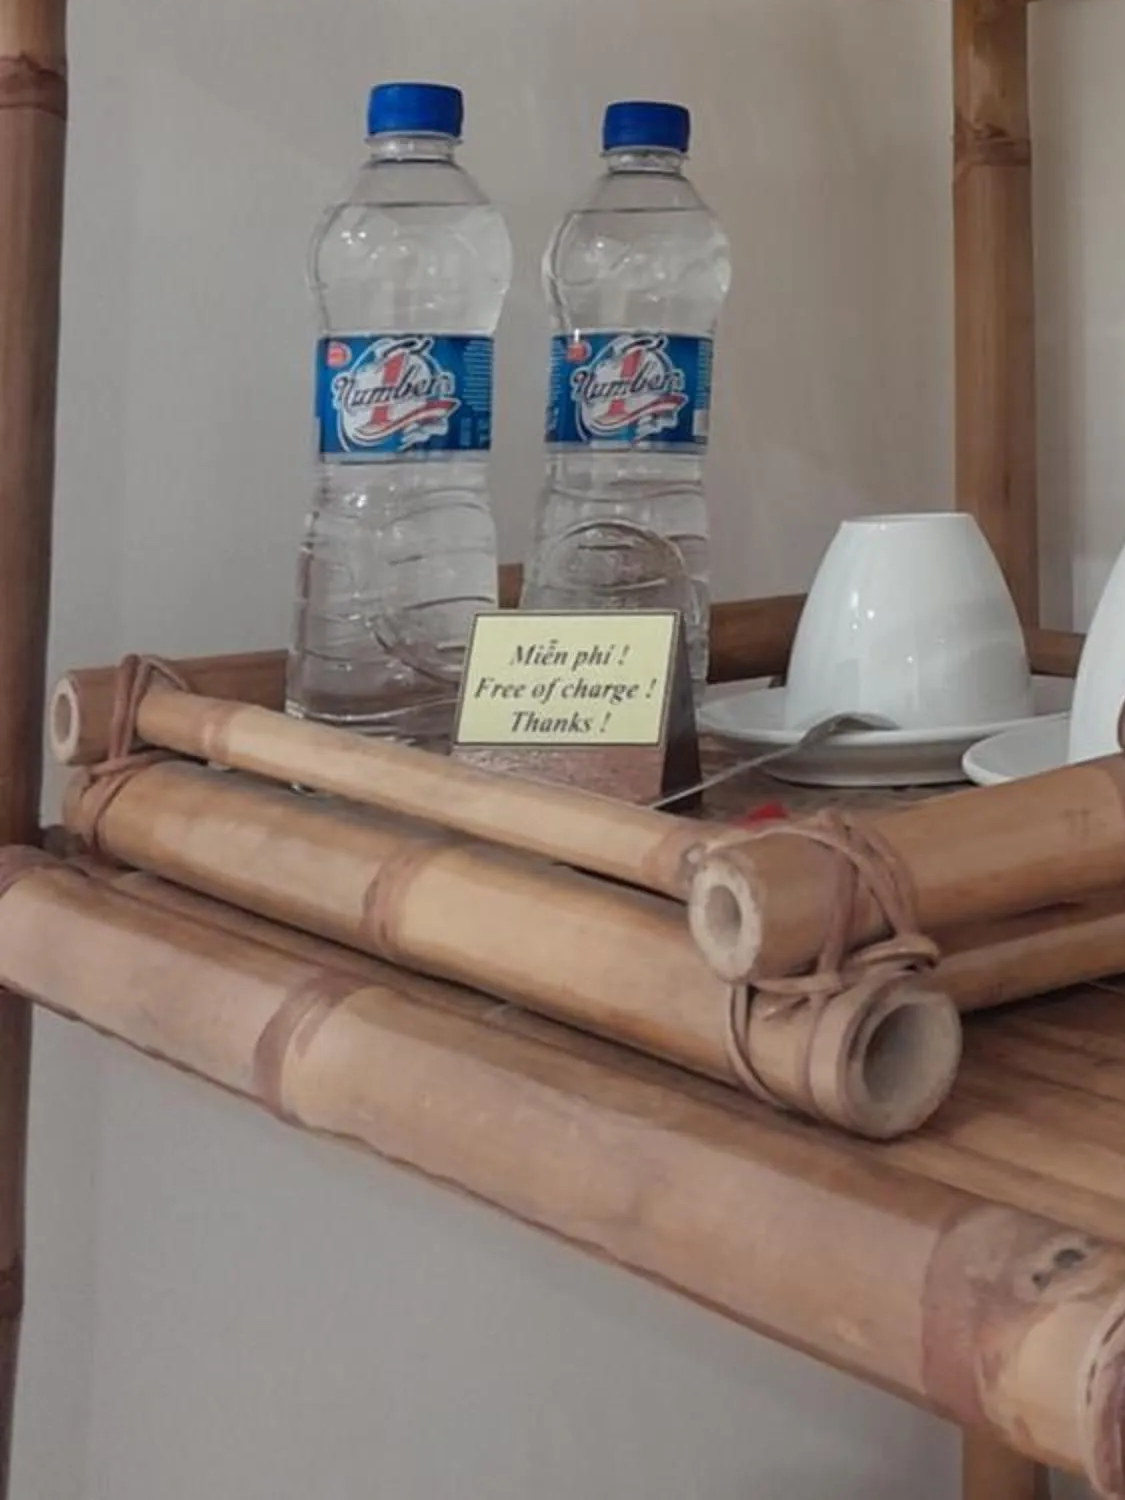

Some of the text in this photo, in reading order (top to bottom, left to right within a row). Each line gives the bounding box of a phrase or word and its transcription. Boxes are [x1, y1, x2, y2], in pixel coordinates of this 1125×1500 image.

[510, 639, 567, 667] Miễn
[474, 677, 526, 699] Free
[530, 677, 561, 705] of
[561, 677, 640, 705] charge
[511, 711, 593, 734] Thanks
